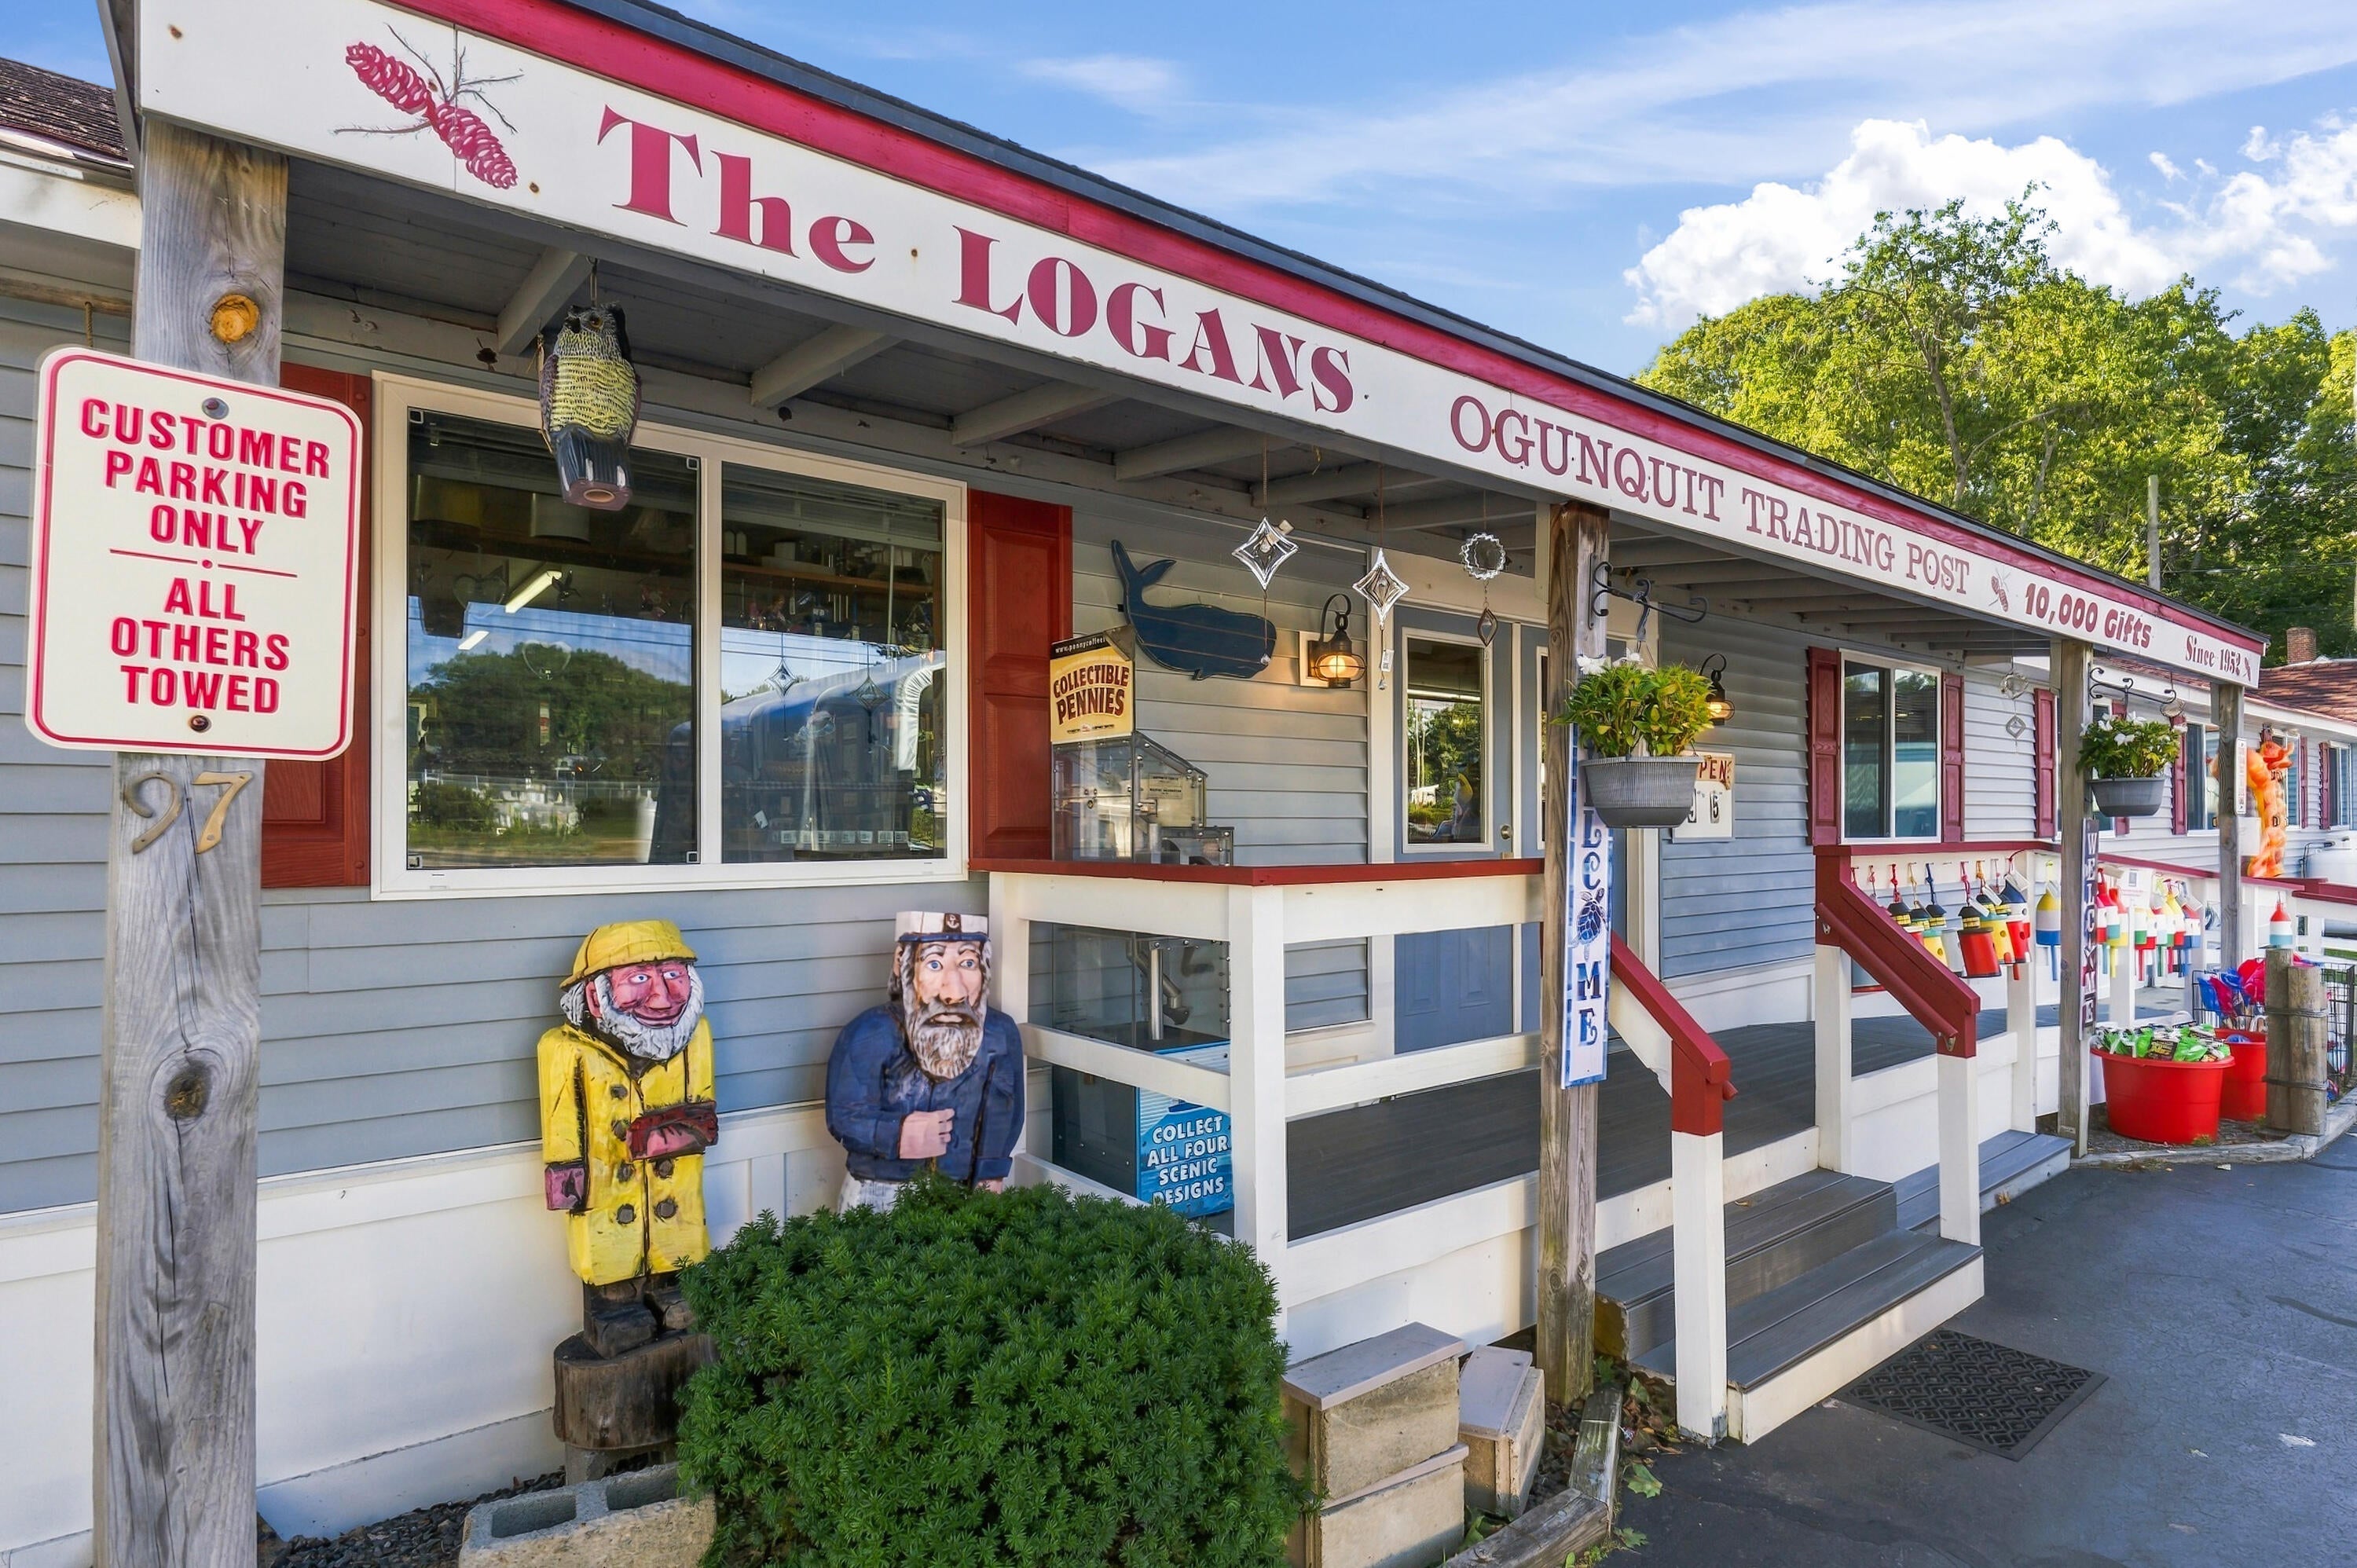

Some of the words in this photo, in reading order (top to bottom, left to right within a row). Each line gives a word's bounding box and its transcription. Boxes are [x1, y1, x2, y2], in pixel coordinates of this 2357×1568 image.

[597, 104, 876, 274] The
[951, 225, 1354, 414] LOGANS
[81, 397, 331, 479] CUSTOMER
[104, 452, 307, 519] PARKING
[1450, 395, 1725, 522] OGUNQUIT
[1742, 487, 1896, 573] TRADING
[1905, 544, 1970, 595] POST
[150, 504, 264, 555] ONLY
[163, 577, 246, 622] ALL
[2025, 583, 2099, 633] 10,000
[2104, 609, 2152, 648] Gifts
[110, 617, 291, 671] OTHERS
[2185, 635, 2215, 668] Since
[2220, 648, 2241, 676] 1952
[120, 665, 280, 714] TOWED
[1053, 665, 1130, 698] COLLECTIBLE
[1056, 687, 1125, 725] PENNIES
[1699, 760, 1728, 779] PEN
[124, 770, 255, 855] 97
[1147, 1145, 1178, 1167] ALL
[1185, 1134, 1229, 1160] FOUR
[1153, 1116, 1223, 1145] COLLECT
[1153, 1176, 1225, 1205] DESIGNS
[1159, 1157, 1218, 1186] SCENIC
